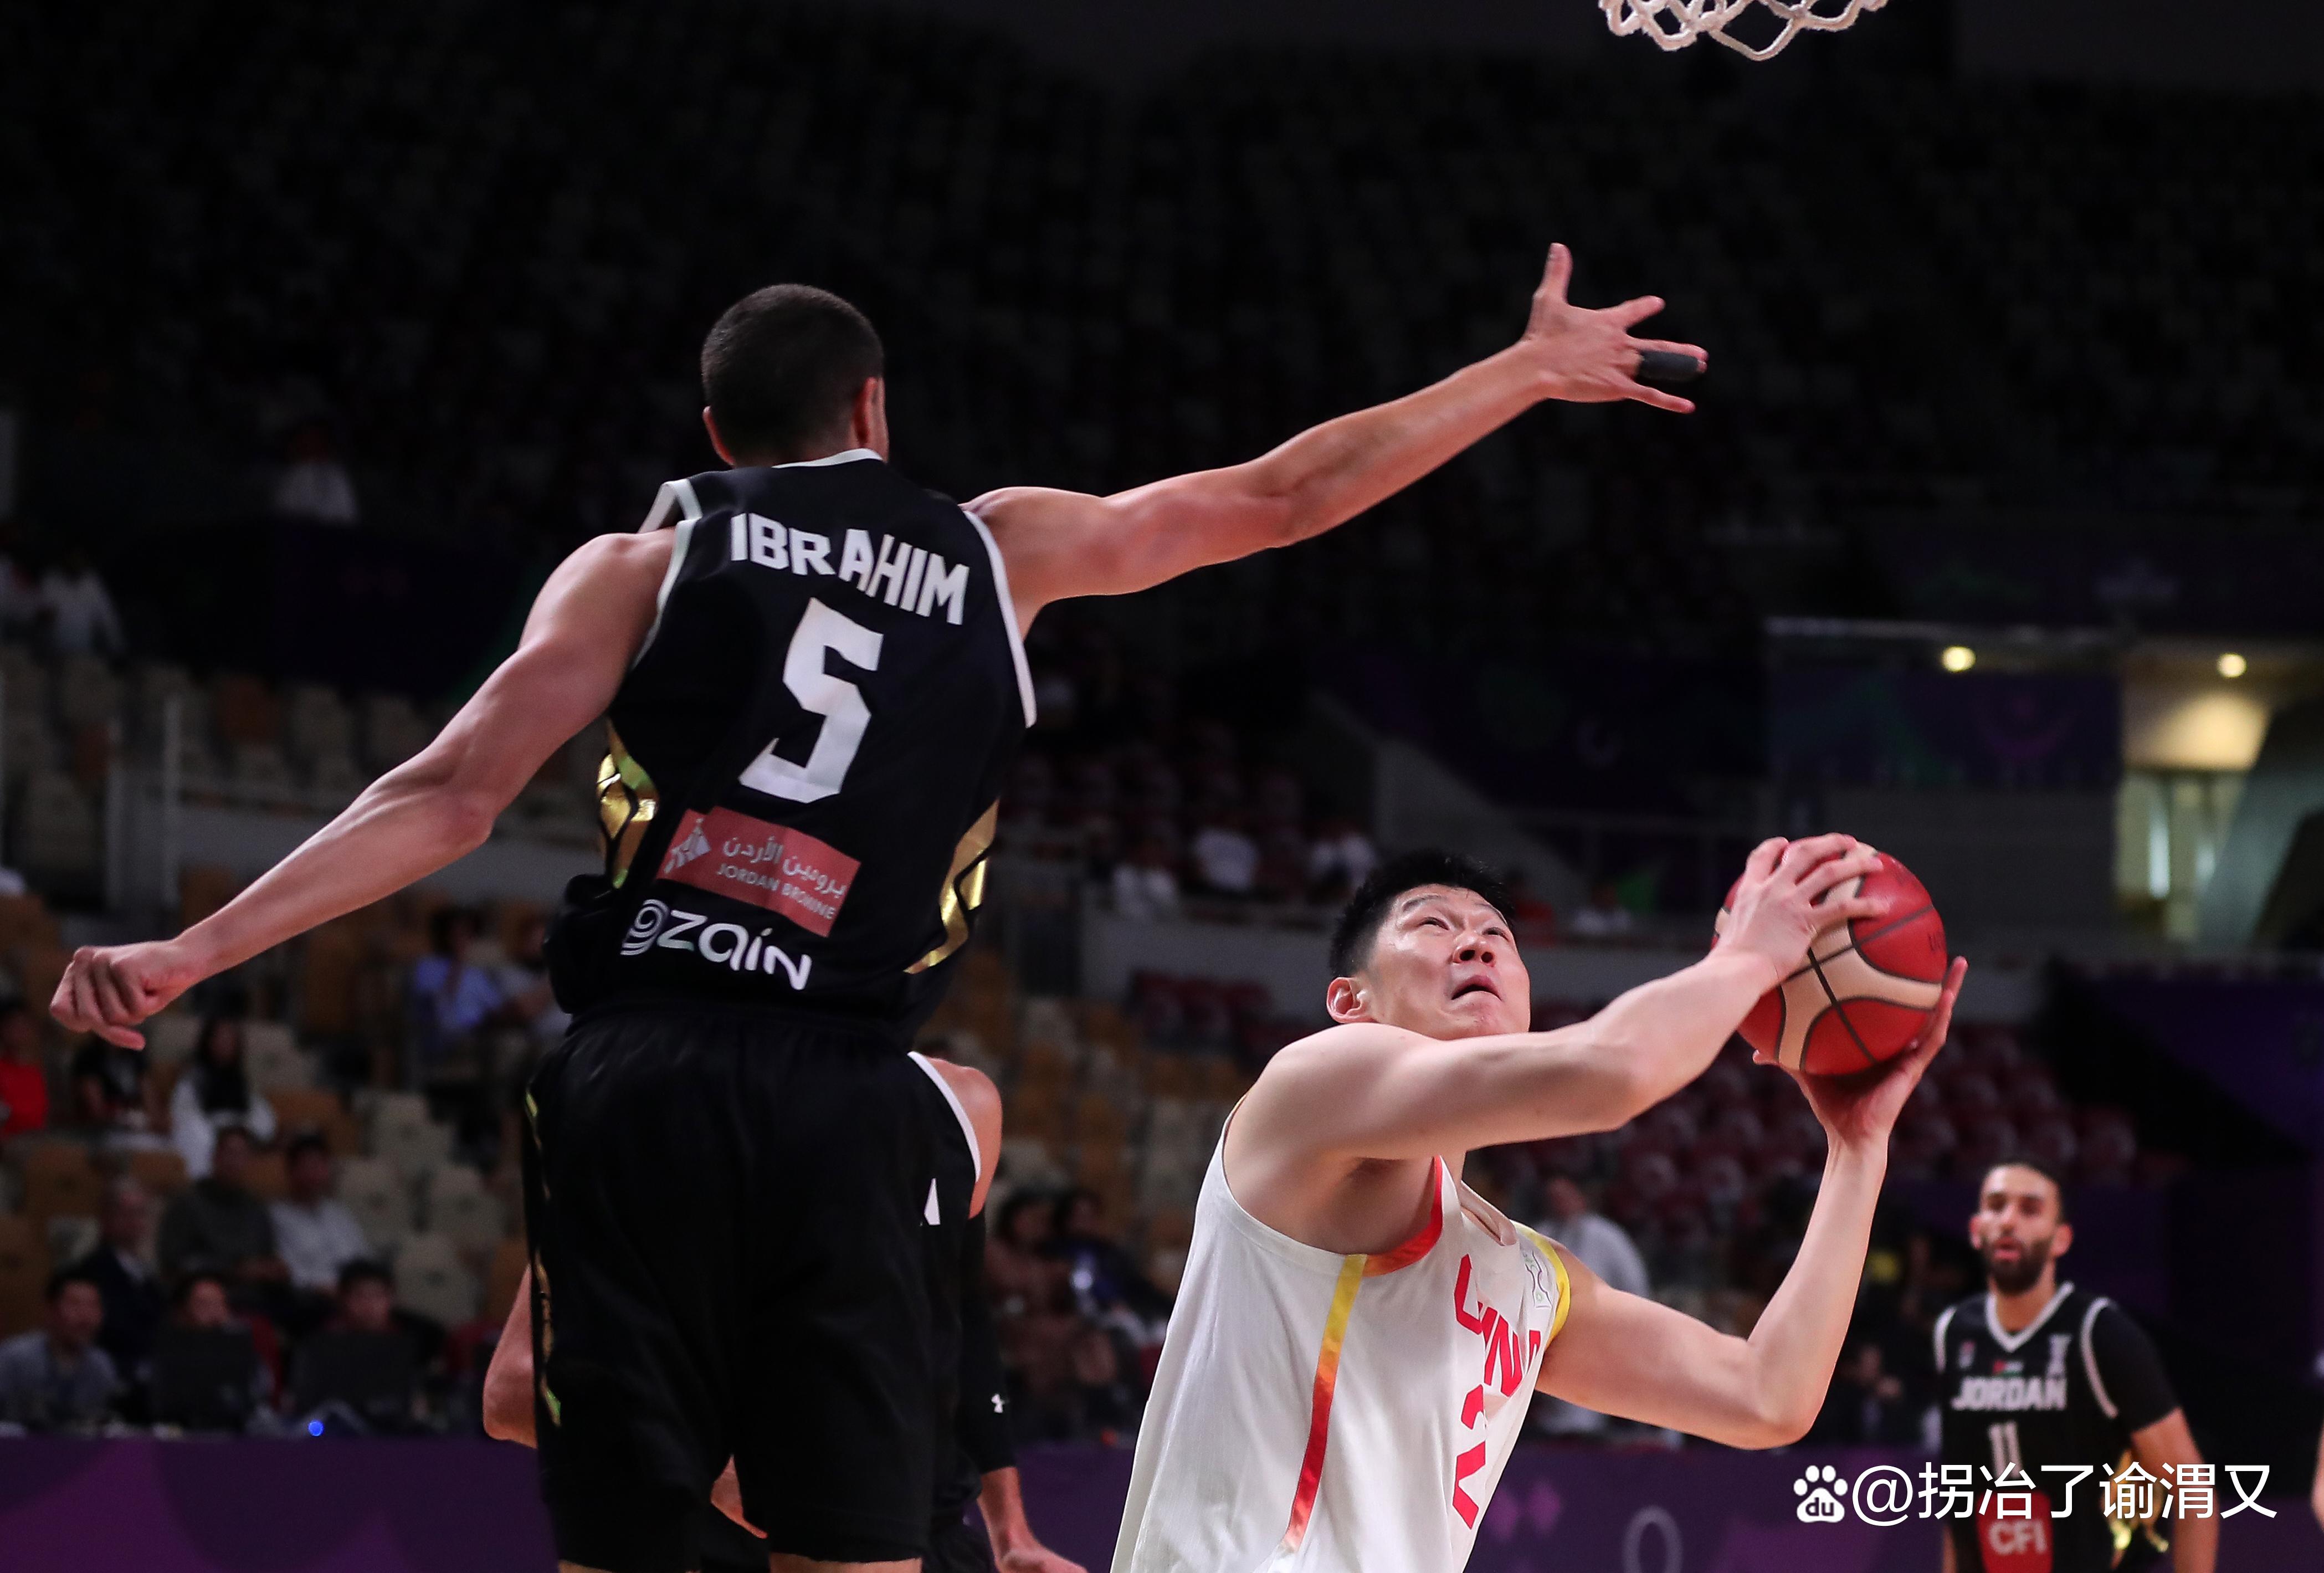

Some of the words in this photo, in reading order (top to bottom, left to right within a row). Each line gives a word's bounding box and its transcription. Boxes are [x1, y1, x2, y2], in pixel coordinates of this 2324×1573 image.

[731, 513, 969, 625] IBRAHIM
[739, 597, 883, 803] 5
[717, 863, 779, 891] JORDAN
[781, 883, 836, 919] BROMINE
[656, 909, 812, 990] zain
[1951, 1376, 2068, 1411] JORDAN
[1987, 1519, 2048, 1555] CFI
